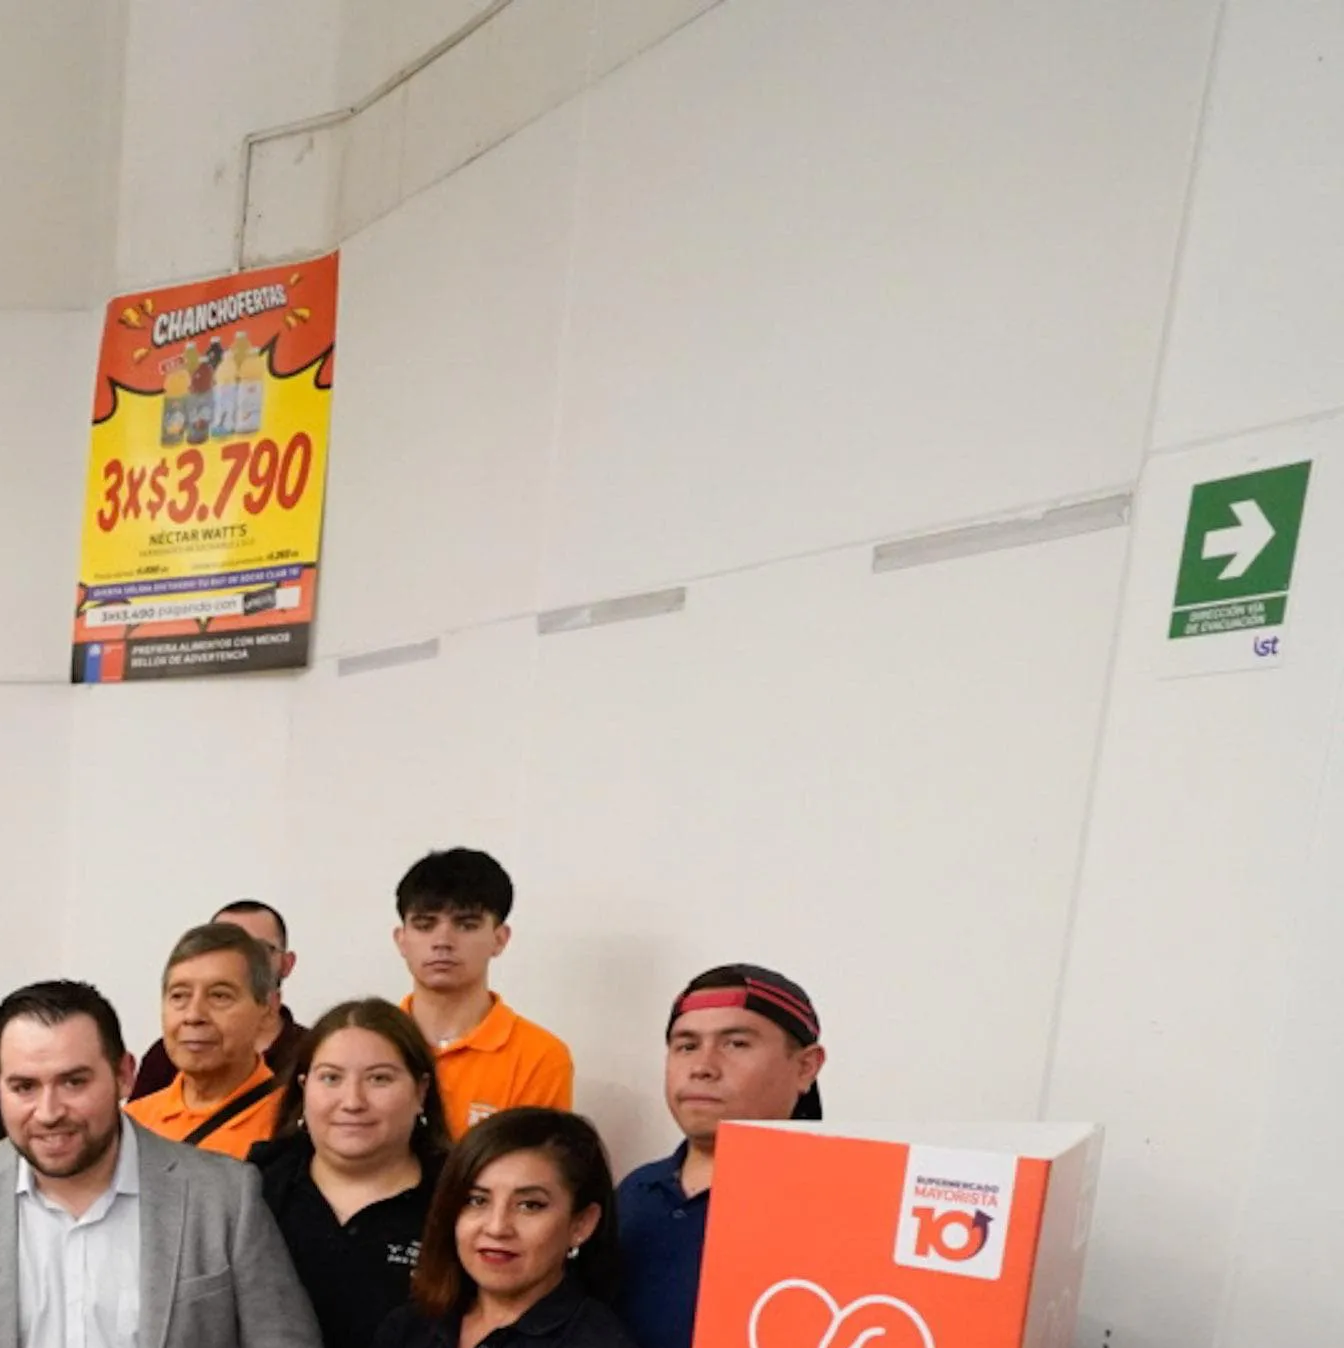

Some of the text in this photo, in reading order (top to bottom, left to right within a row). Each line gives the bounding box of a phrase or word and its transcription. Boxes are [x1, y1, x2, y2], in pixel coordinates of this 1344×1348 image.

[152, 284, 287, 344] CHANCHOFERTAS
[915, 1185, 998, 1207] MAYORISTA
[911, 1206, 992, 1262] 10
